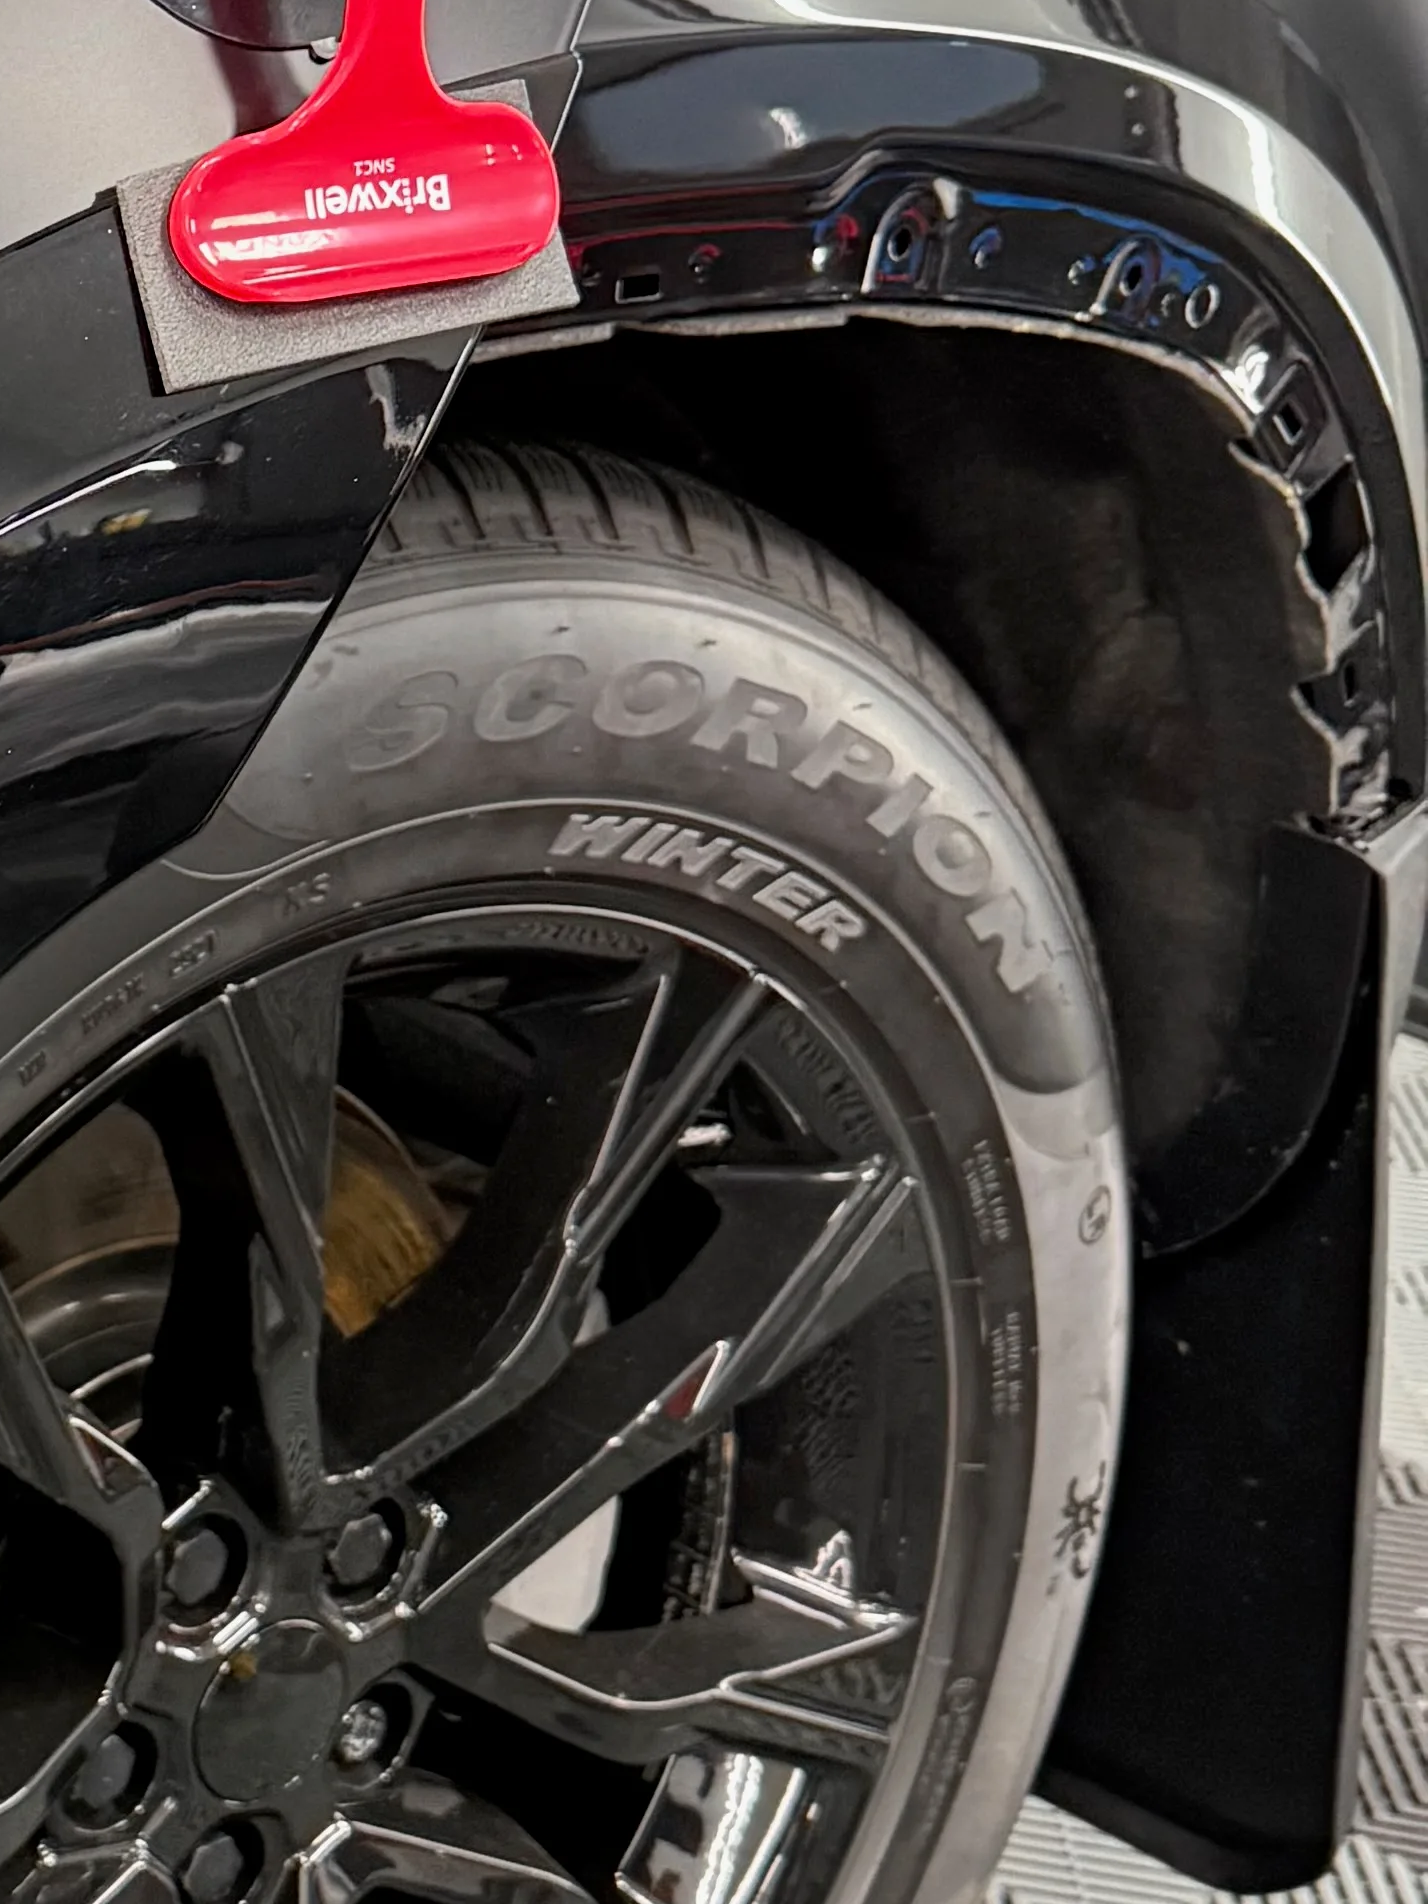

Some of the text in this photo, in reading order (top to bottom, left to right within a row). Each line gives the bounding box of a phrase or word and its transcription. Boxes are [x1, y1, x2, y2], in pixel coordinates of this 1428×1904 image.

[305, 174, 451, 220] Brixwell
[354, 158, 395, 176] SNC1
[348, 652, 1068, 993] SCORPION
[549, 813, 869, 951] WINTER
